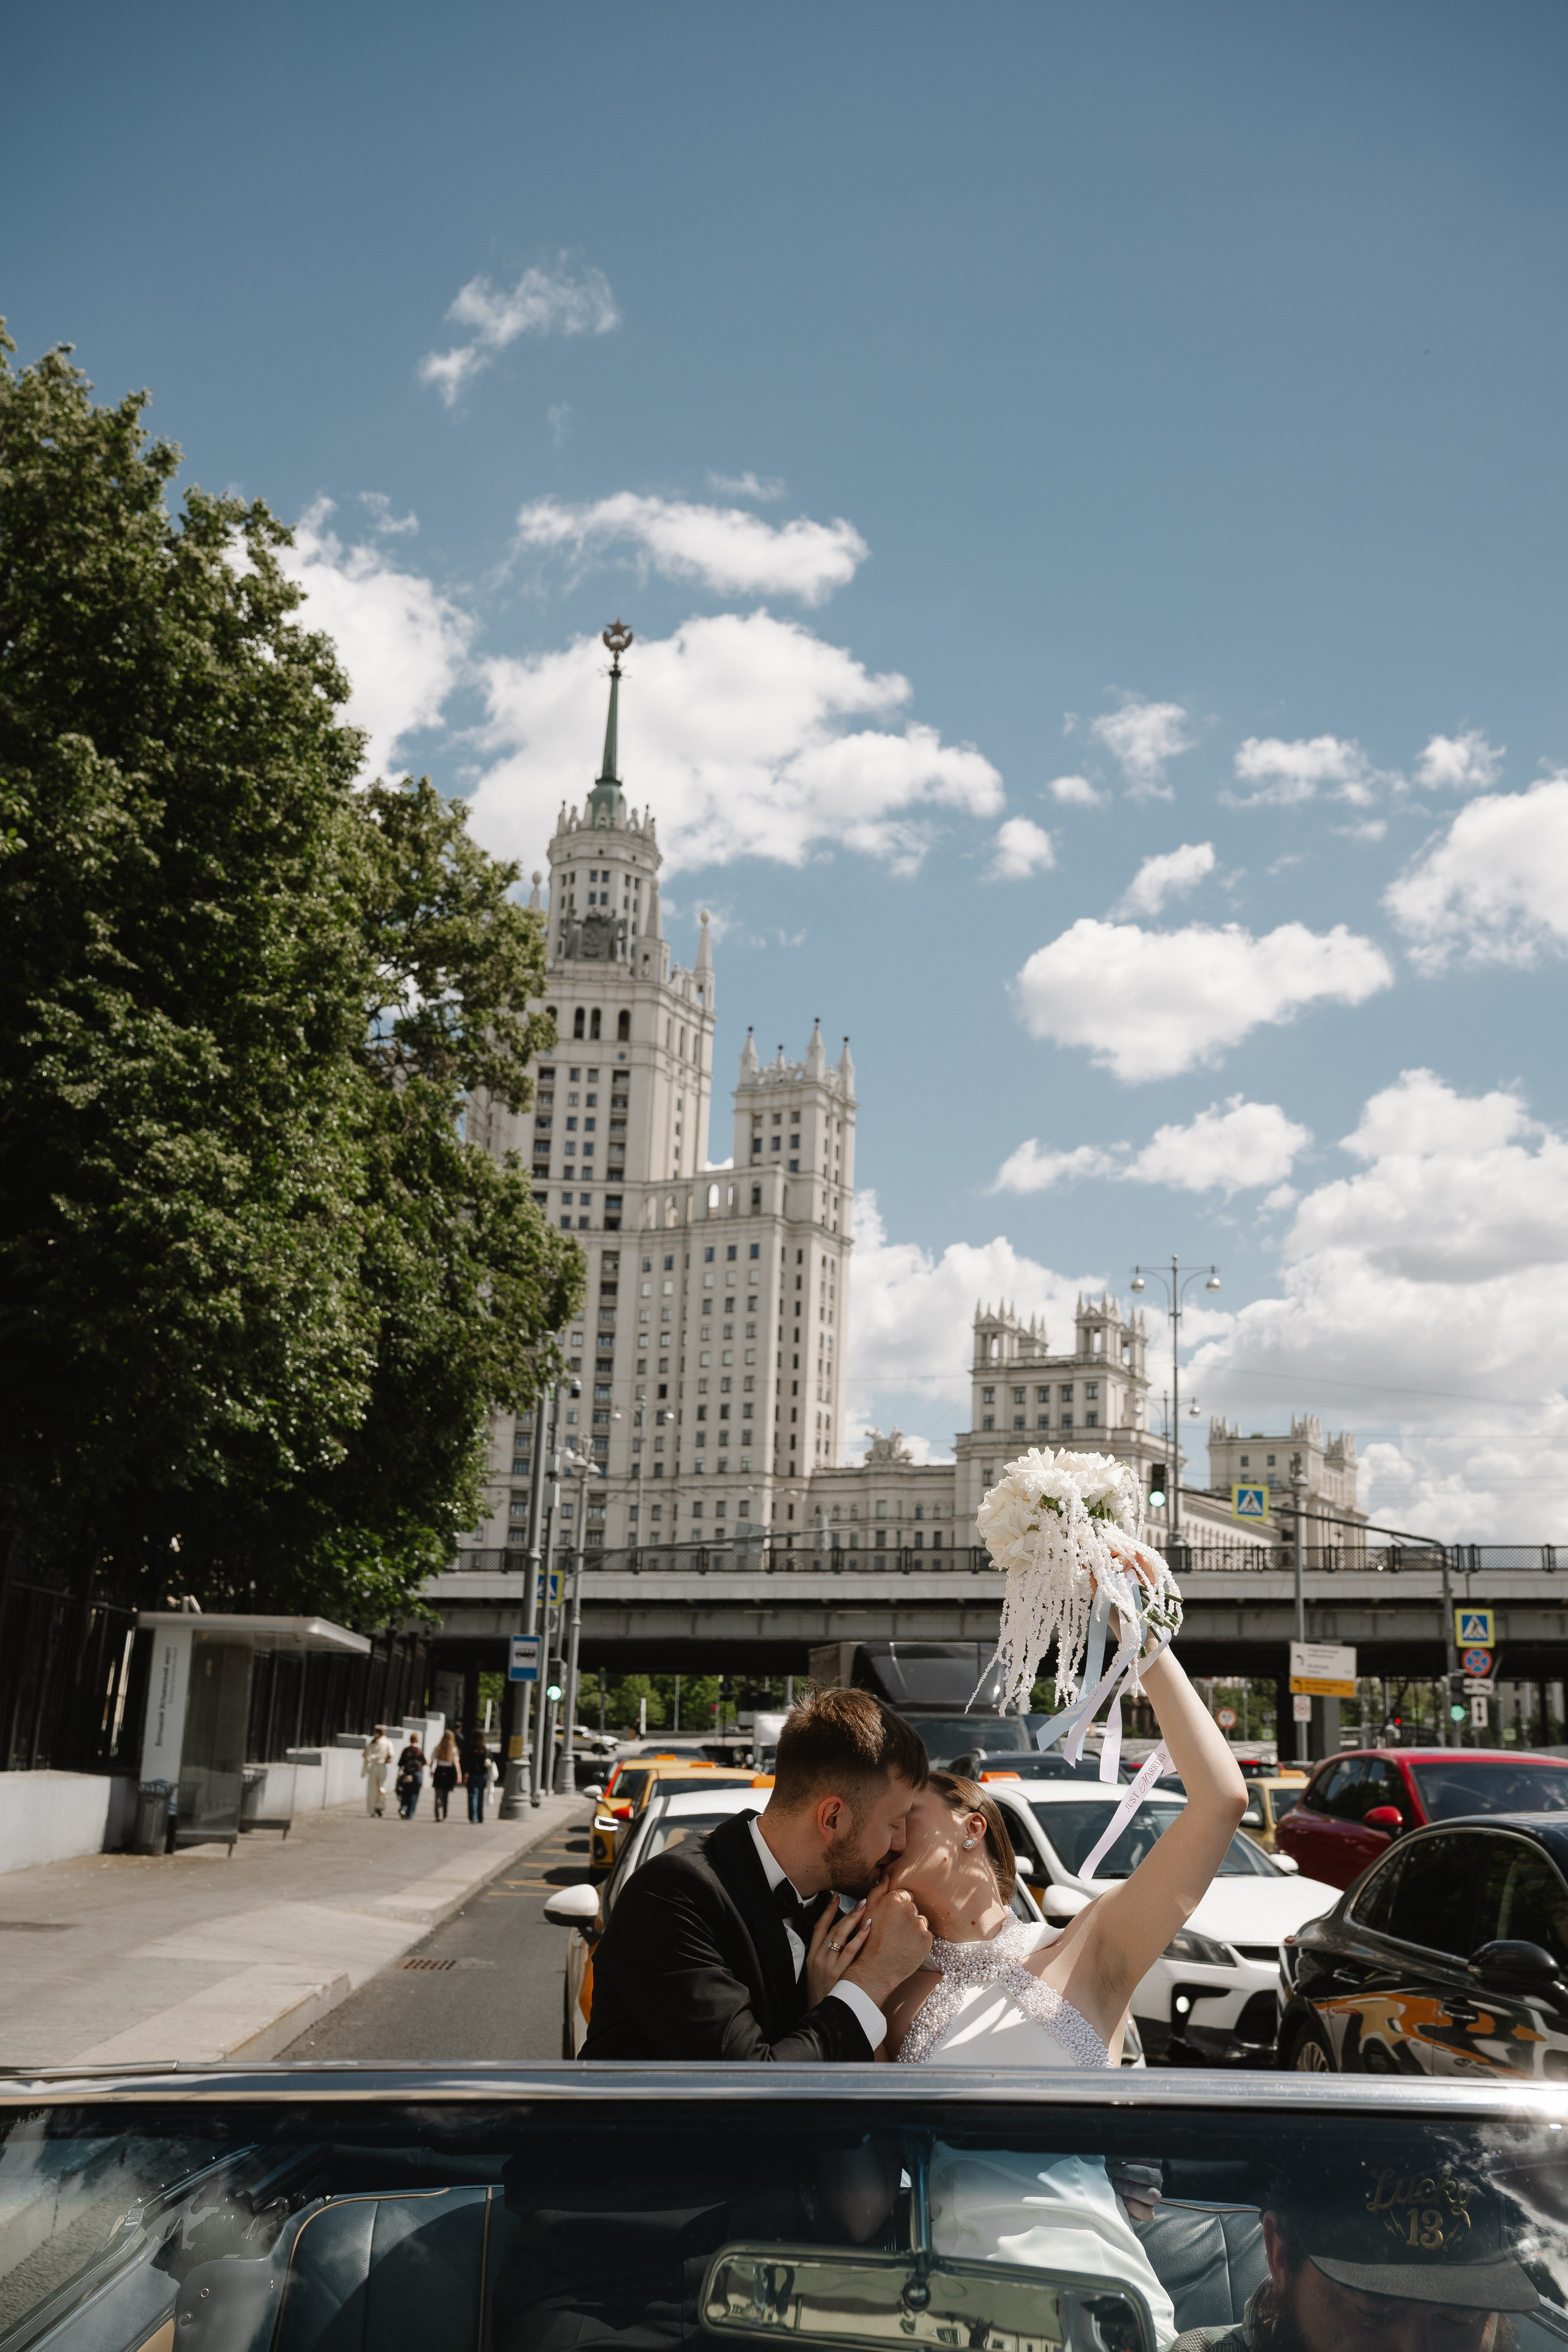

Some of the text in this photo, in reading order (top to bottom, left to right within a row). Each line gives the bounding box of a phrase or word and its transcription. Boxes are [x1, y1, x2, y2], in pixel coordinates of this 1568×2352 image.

[1125, 1753, 1167, 1812] JUST MARRIED
[1366, 2165, 1472, 2228] Lucky
[1406, 2207, 1444, 2250] 13
